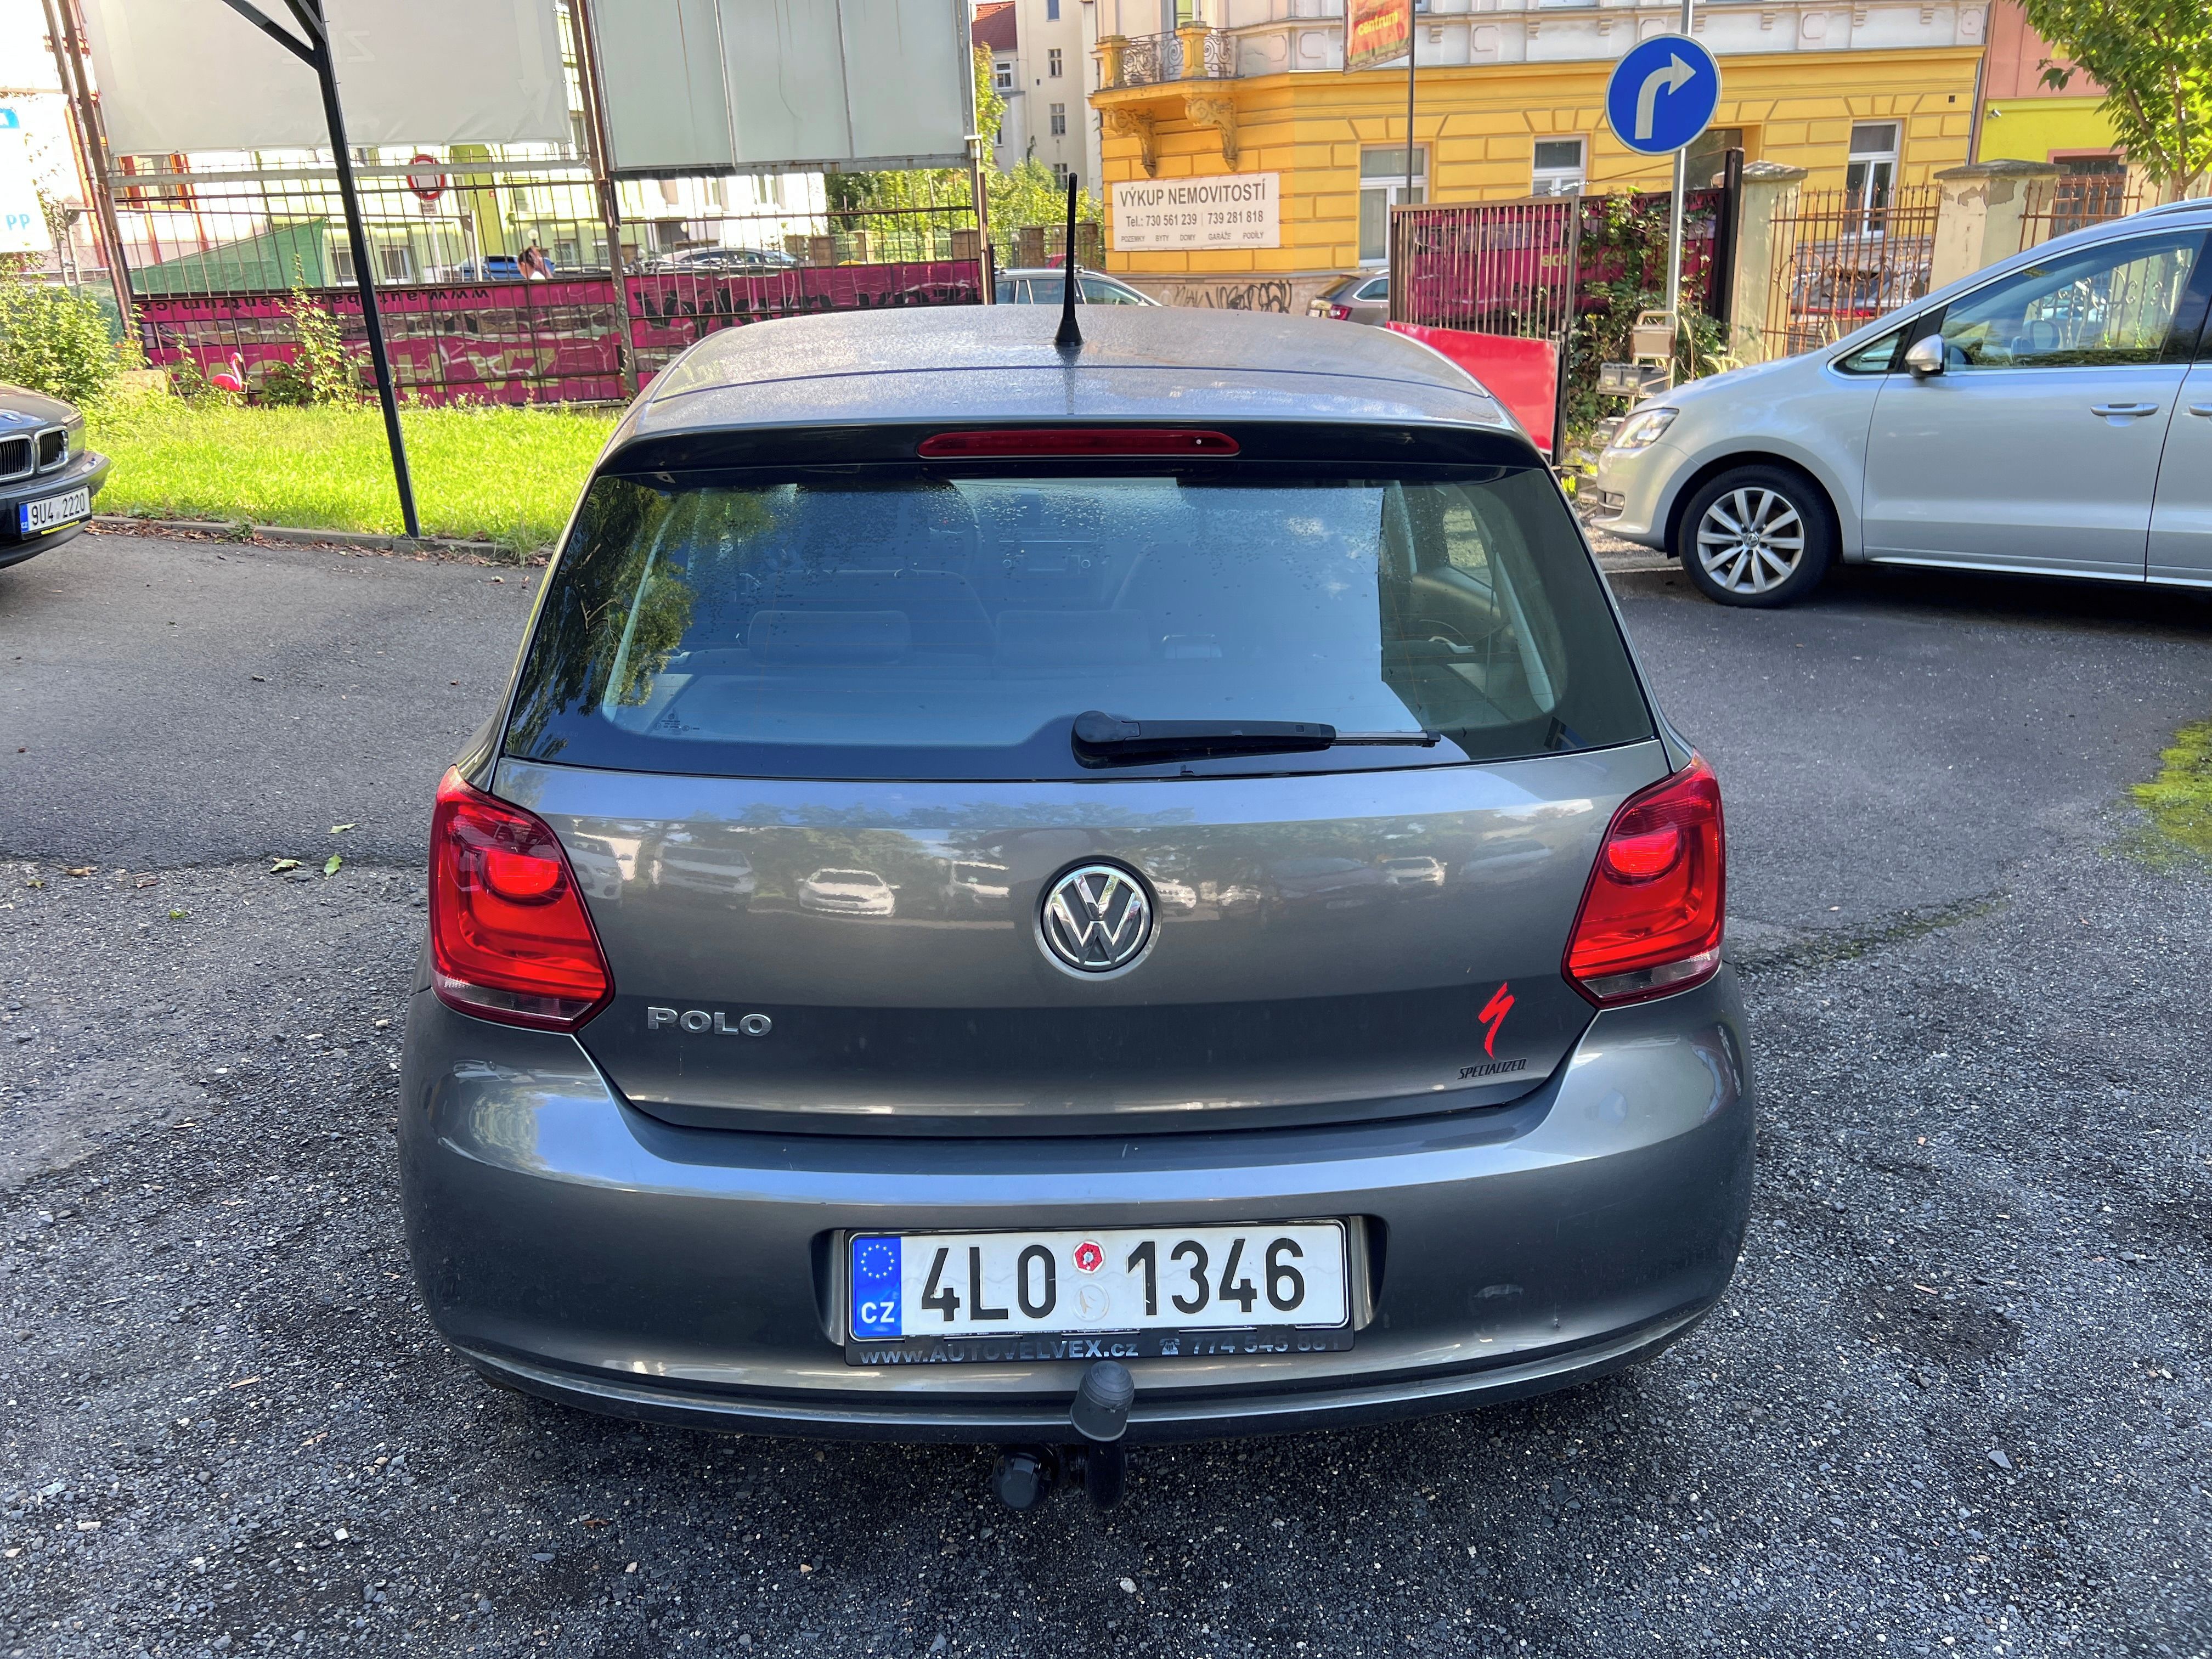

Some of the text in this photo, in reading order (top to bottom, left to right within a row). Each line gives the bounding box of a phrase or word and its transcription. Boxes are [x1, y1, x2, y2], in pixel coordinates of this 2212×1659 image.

[1358, 10, 1398, 36] centrum
[1120, 178, 1265, 207] VÝKUP NEMOVITOSTÍ
[1146, 215, 1161, 226] 730
[1163, 214, 1178, 225] 561
[1181, 213, 1197, 225] 239
[1207, 212, 1224, 224] 739
[1227, 211, 1243, 223] 281
[1246, 210, 1263, 223] 818
[31, 492, 85, 526] 9U4 2220
[647, 1006, 773, 1037] POLO
[1457, 1058, 1527, 1080] SPECIALIZED
[861, 1301, 896, 1325] CZ
[1126, 1238, 1305, 1317] 1346
[859, 1339, 1139, 1365] www.AUTOVELVEX.cz
[1190, 1335, 1235, 1355] 774
[1244, 1334, 1289, 1353] 545
